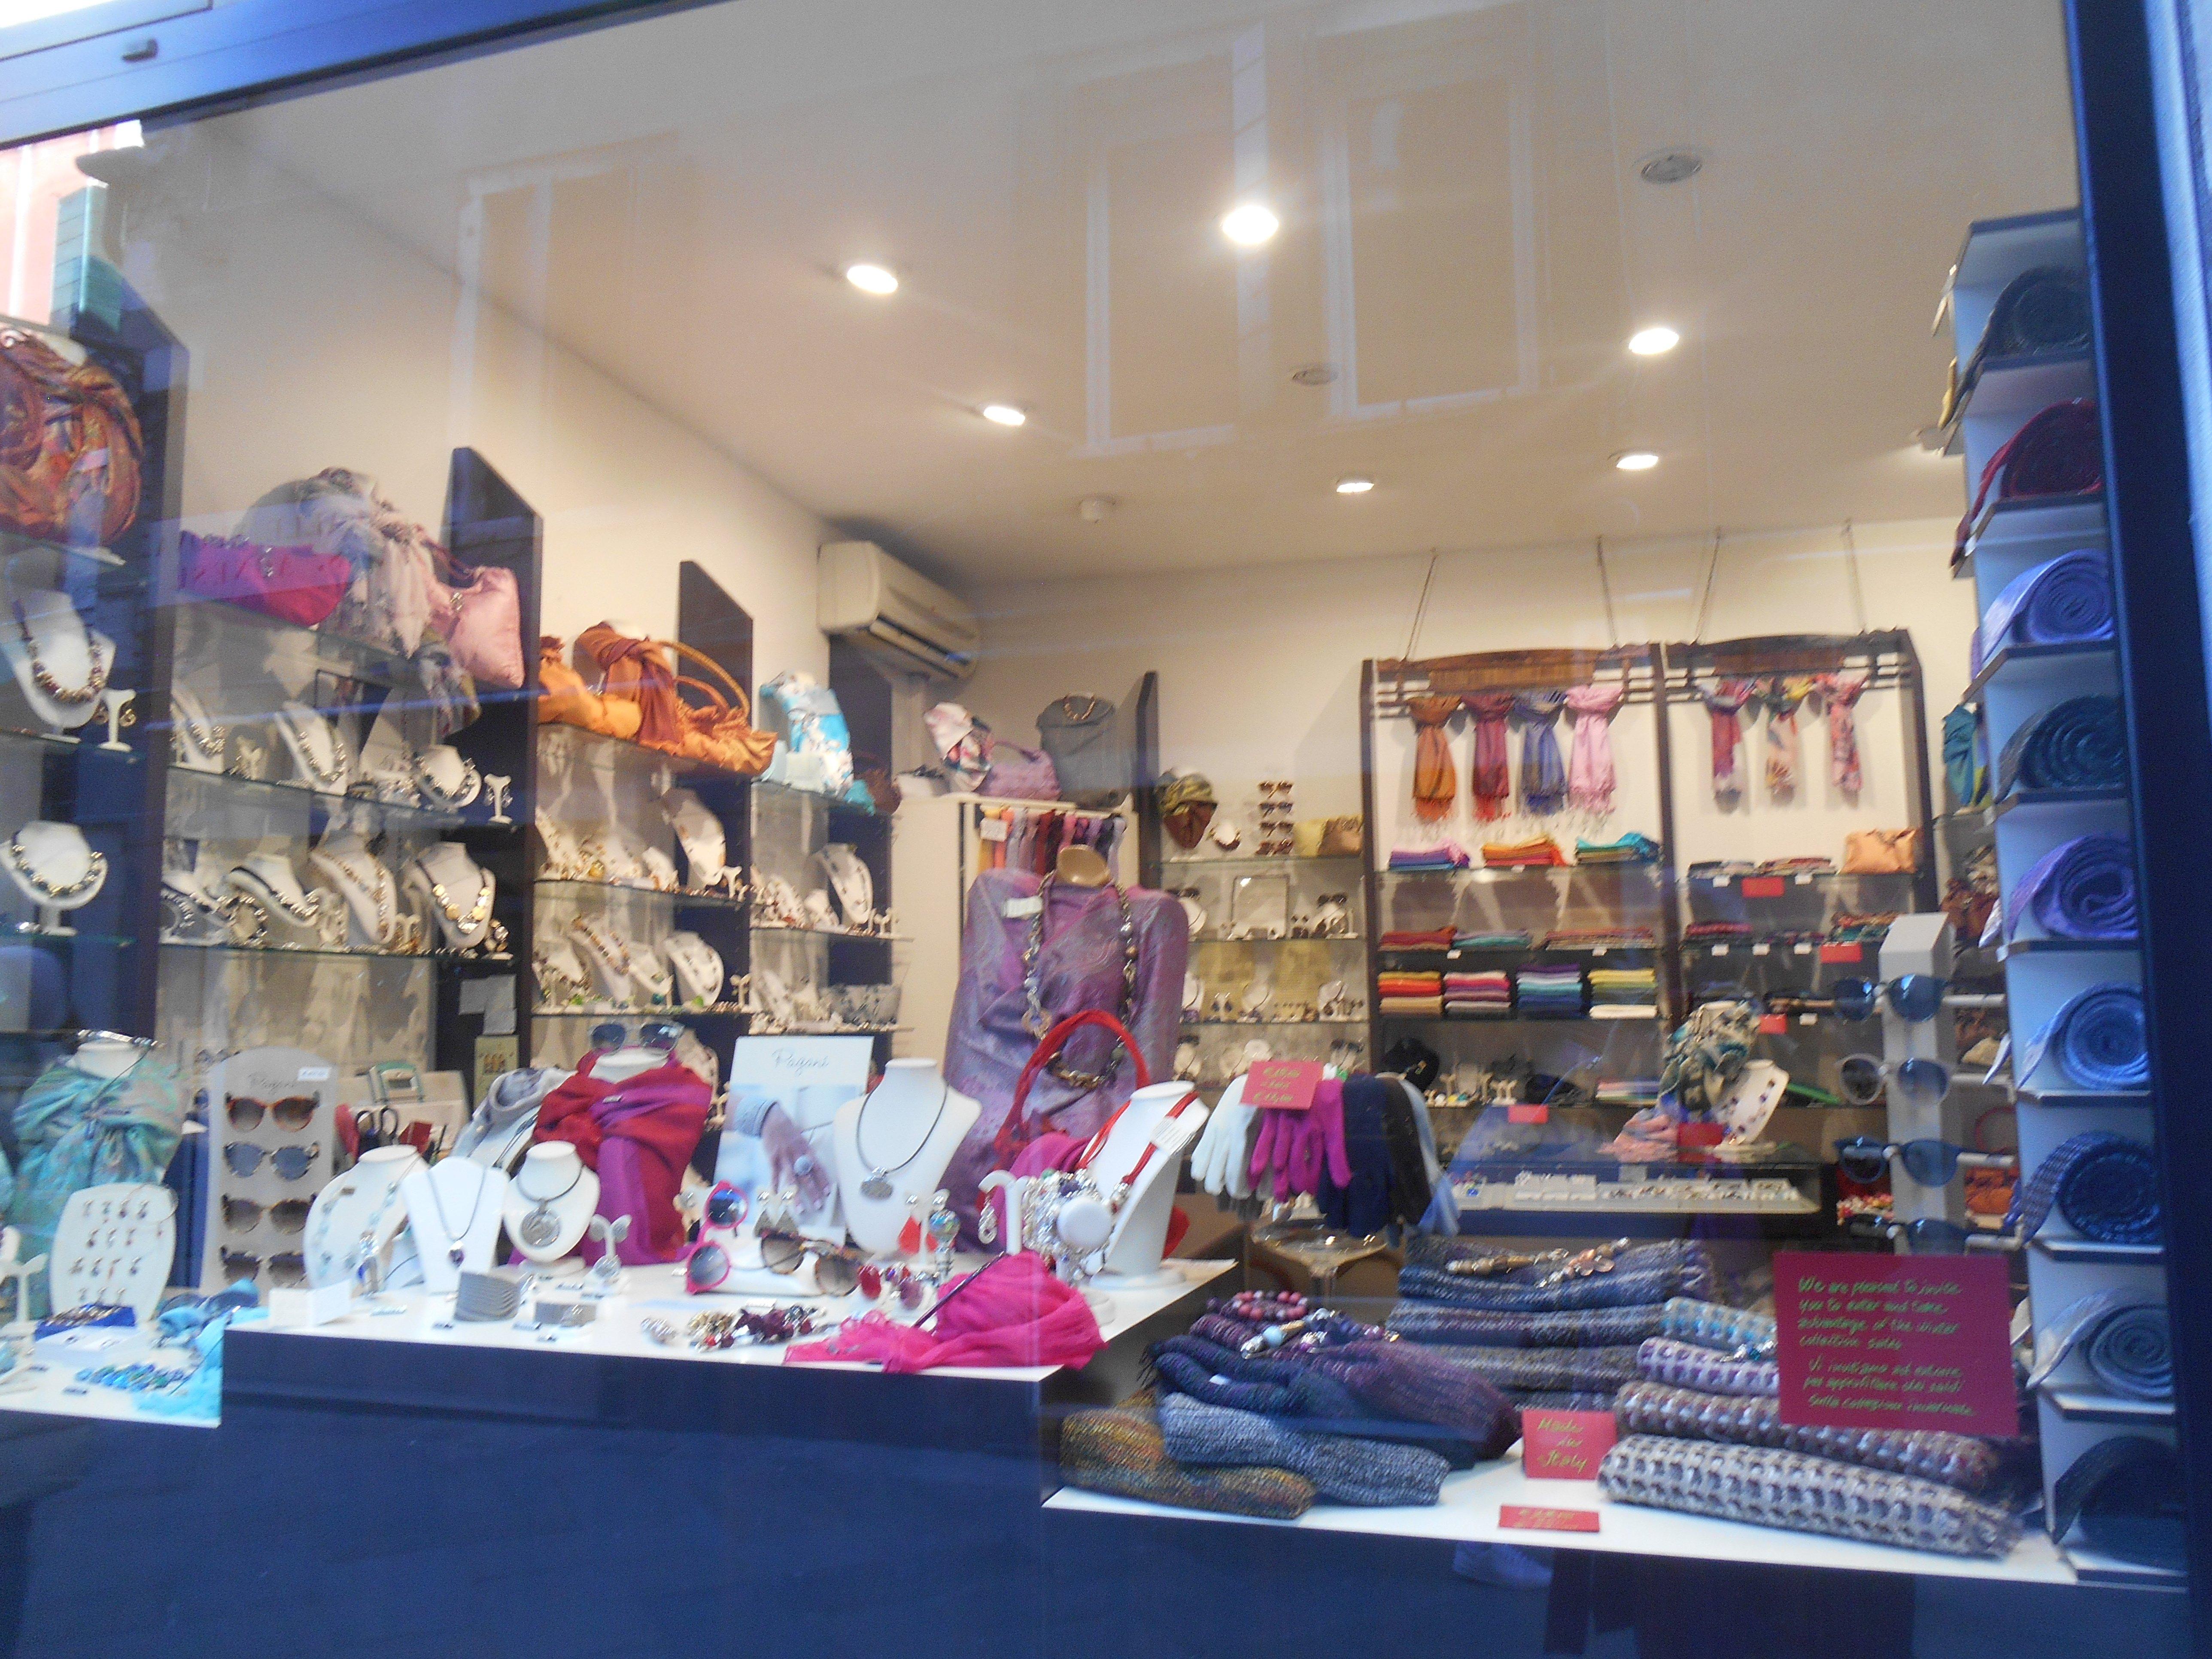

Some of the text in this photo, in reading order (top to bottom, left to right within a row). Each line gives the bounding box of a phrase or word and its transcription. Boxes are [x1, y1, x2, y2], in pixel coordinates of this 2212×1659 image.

[1799, 1277, 1962, 1296] We are pleased to invite
[1799, 1300, 1823, 1313] you
[1828, 1299, 1841, 1310] to
[1847, 1300, 1880, 1310] enter
[1884, 1302, 1908, 1312] and
[1799, 1316, 1867, 1334] advantage
[1892, 1319, 1911, 1330] the
